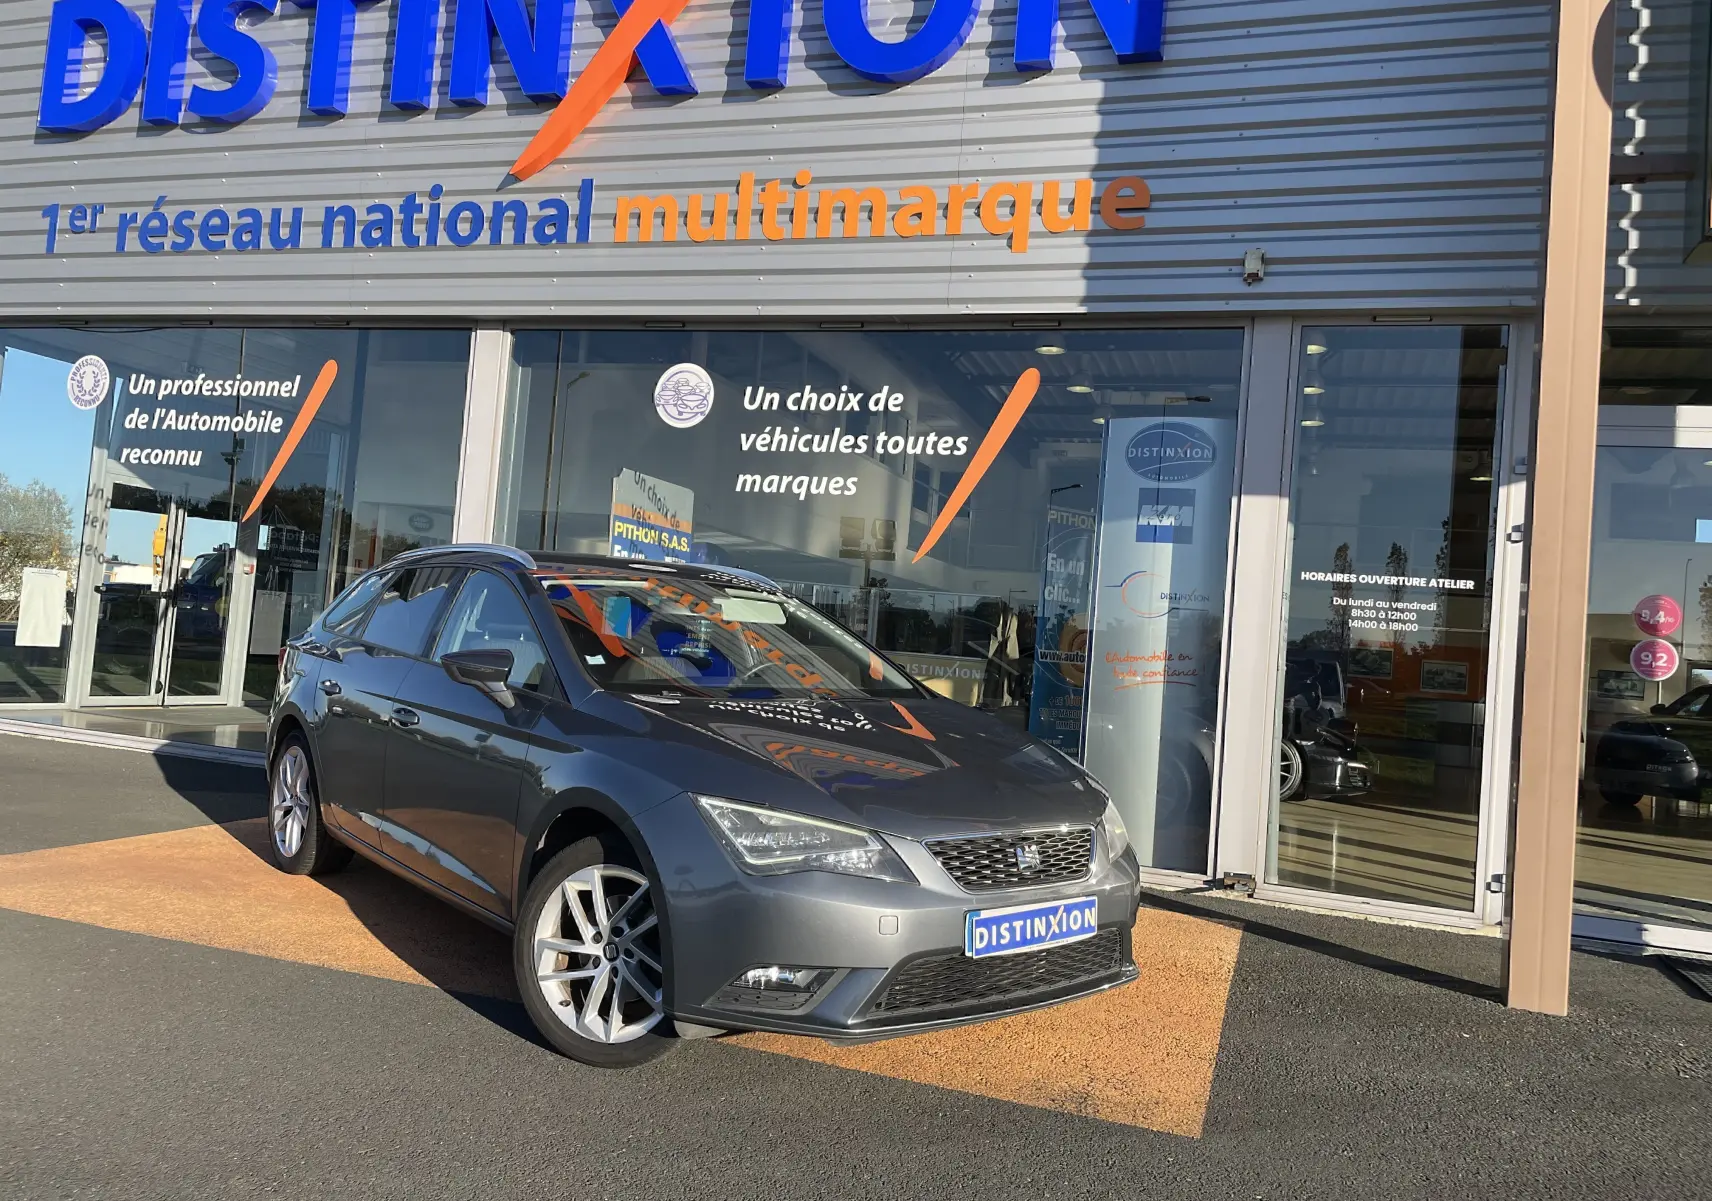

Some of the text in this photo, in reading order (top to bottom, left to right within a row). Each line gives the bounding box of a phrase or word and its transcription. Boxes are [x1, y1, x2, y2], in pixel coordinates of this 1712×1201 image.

[41, 169, 1151, 254] 1er réseau national multimarque
[128, 373, 302, 400] Un professionnel
[743, 384, 905, 412] Un choix de
[124, 407, 284, 433] de l'Automobile
[739, 426, 969, 456] véhicules toutes
[1127, 442, 1213, 461] DISTINXION
[119, 446, 203, 467] reconnu
[735, 472, 859, 501] marques
[1048, 510, 1097, 530] PITHON
[614, 519, 659, 545] PITHON
[661, 532, 691, 553] S.A.S.
[1047, 552, 1065, 573] En
[1300, 571, 1475, 590] HORAIRES OUVERTURE ATELIER
[1160, 588, 1210, 604] DISTINXION
[1332, 597, 1437, 611] Du lundi au vendredi
[1348, 619, 1419, 632] 14h00 à 18h00
[1351, 609, 1417, 621] 8h30 à 12h00
[1142, 664, 1199, 678] confiance
[975, 904, 1096, 949] DISTINXION
